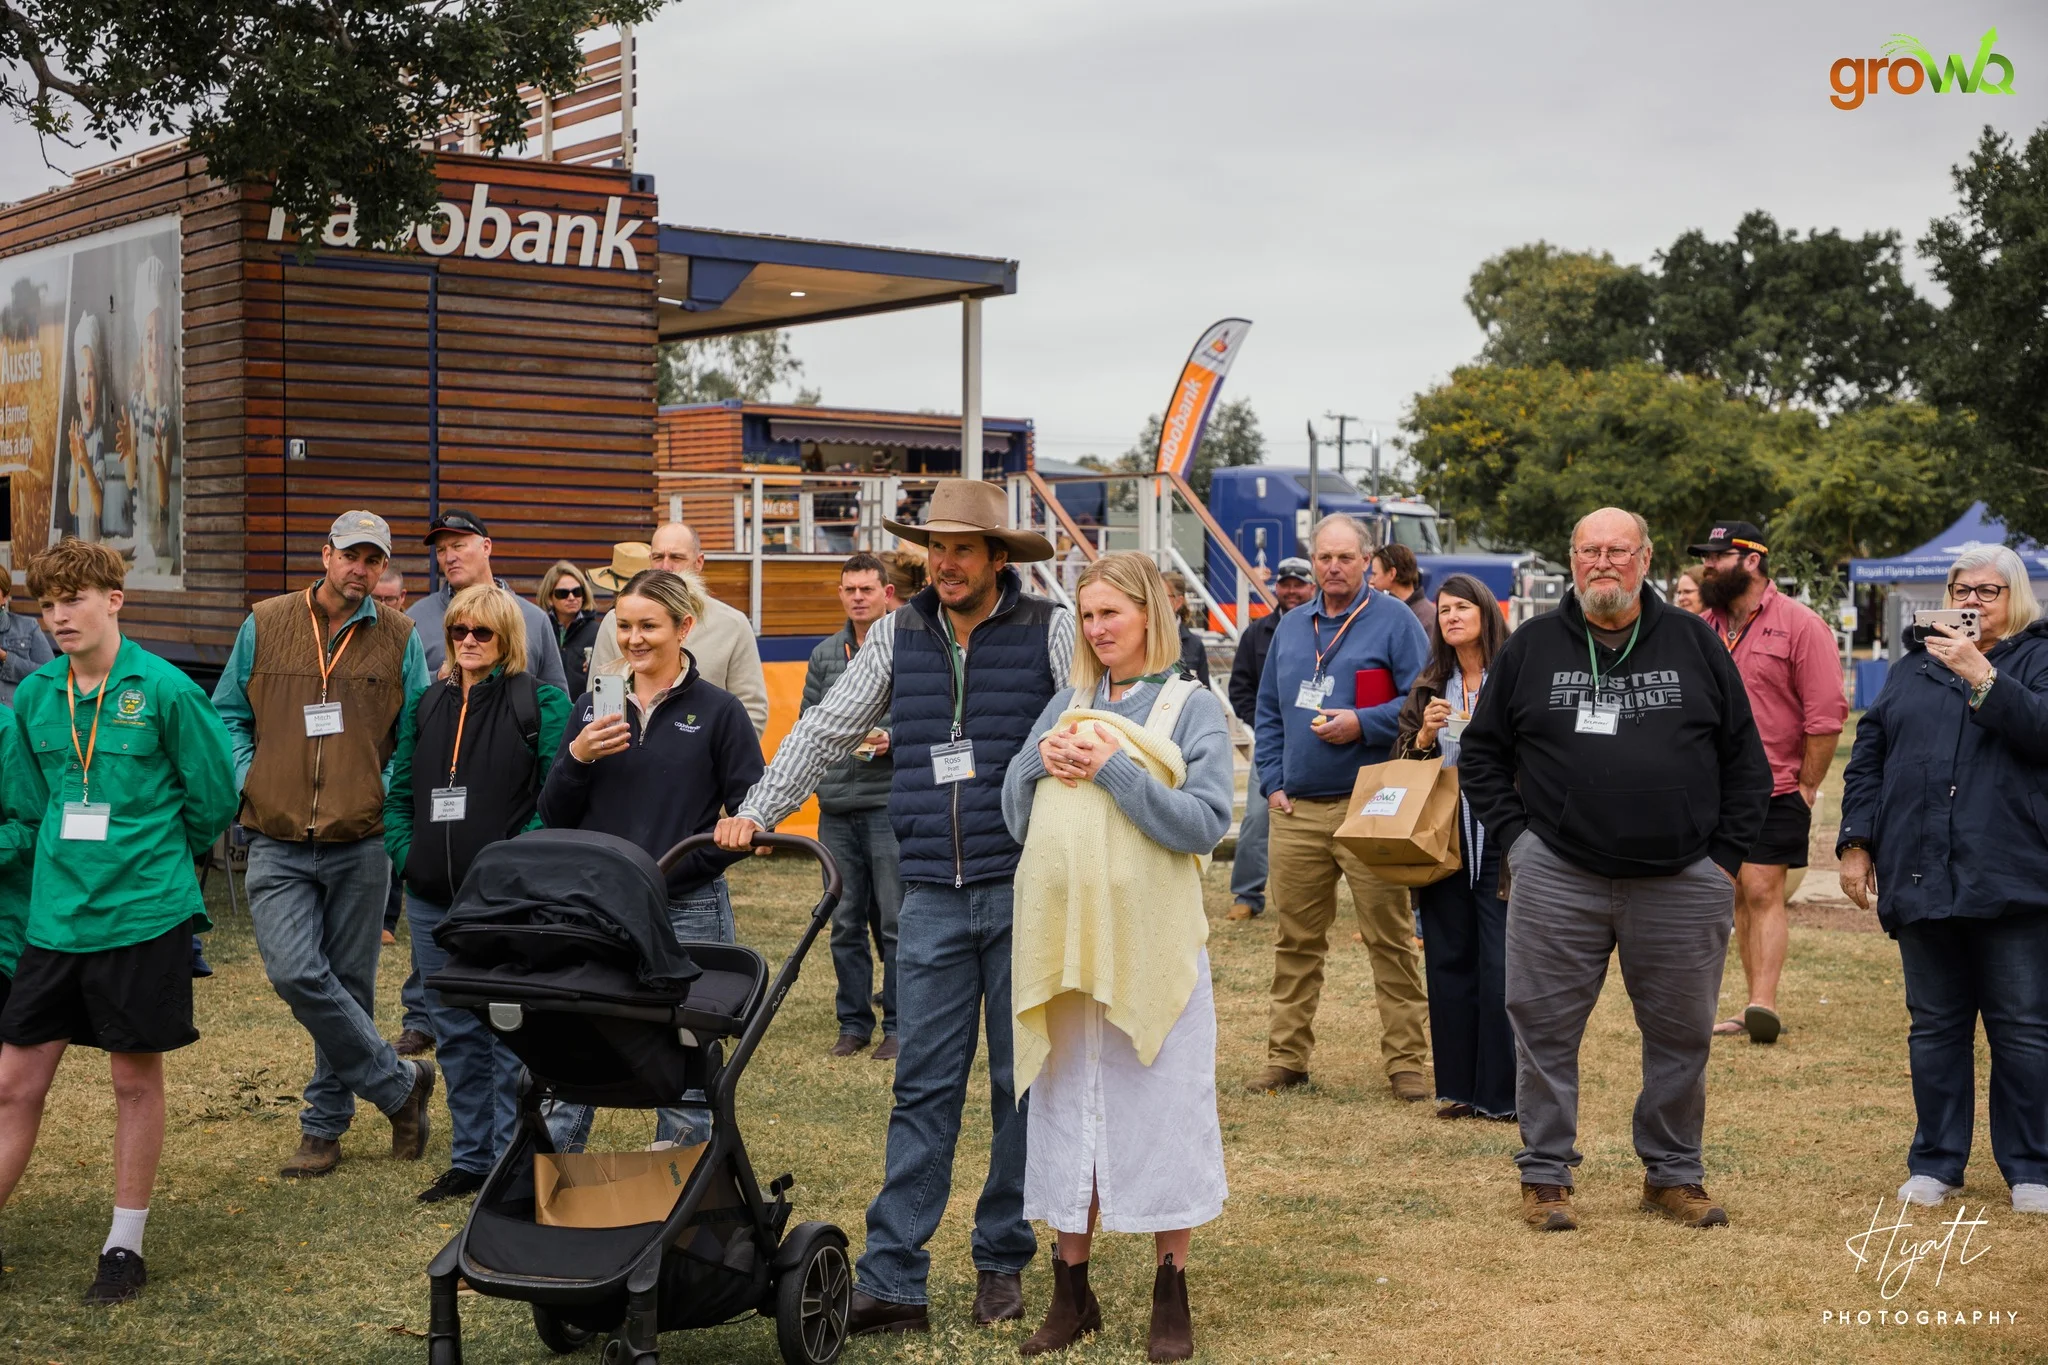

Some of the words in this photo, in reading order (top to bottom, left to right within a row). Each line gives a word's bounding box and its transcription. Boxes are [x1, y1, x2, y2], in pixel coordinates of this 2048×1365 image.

[267, 176, 643, 270] aobank
[2, 340, 42, 384] Aussie
[5, 401, 28, 424] farmer
[20, 432, 33, 460] day
[744, 500, 794, 516] FMERS
[1856, 565, 1883, 578] Royal
[1884, 565, 1914, 578] Flying
[1552, 670, 1680, 690] BOOSTED
